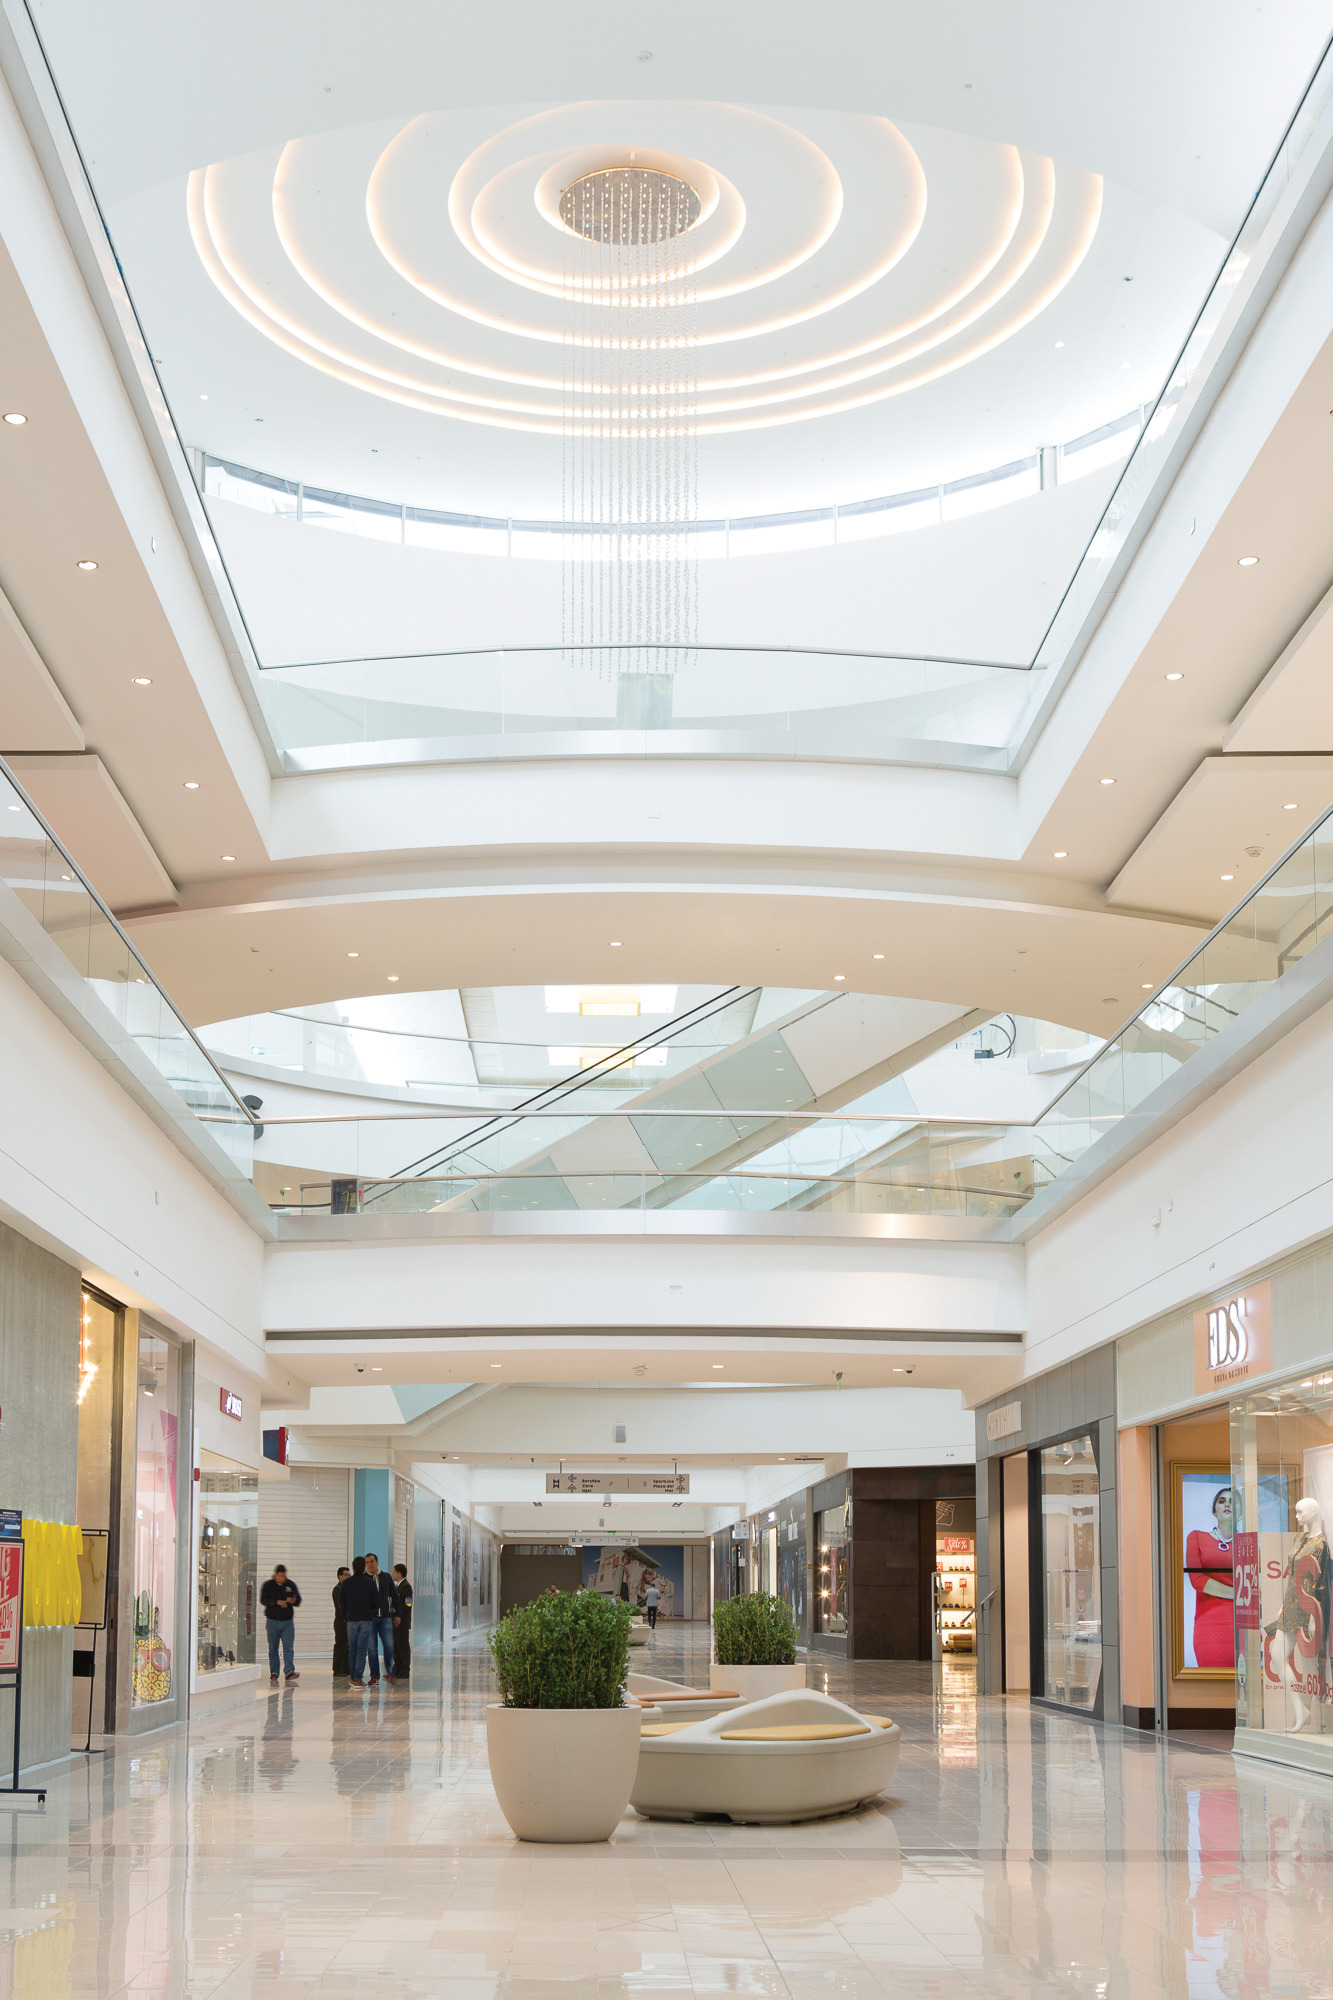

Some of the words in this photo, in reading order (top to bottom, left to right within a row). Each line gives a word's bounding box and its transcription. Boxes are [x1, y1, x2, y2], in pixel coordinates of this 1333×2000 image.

[1238, 1546, 1254, 1557] SALE
[1235, 1564, 1258, 1607] 25%
[1307, 1673, 1325, 1697] 60%
